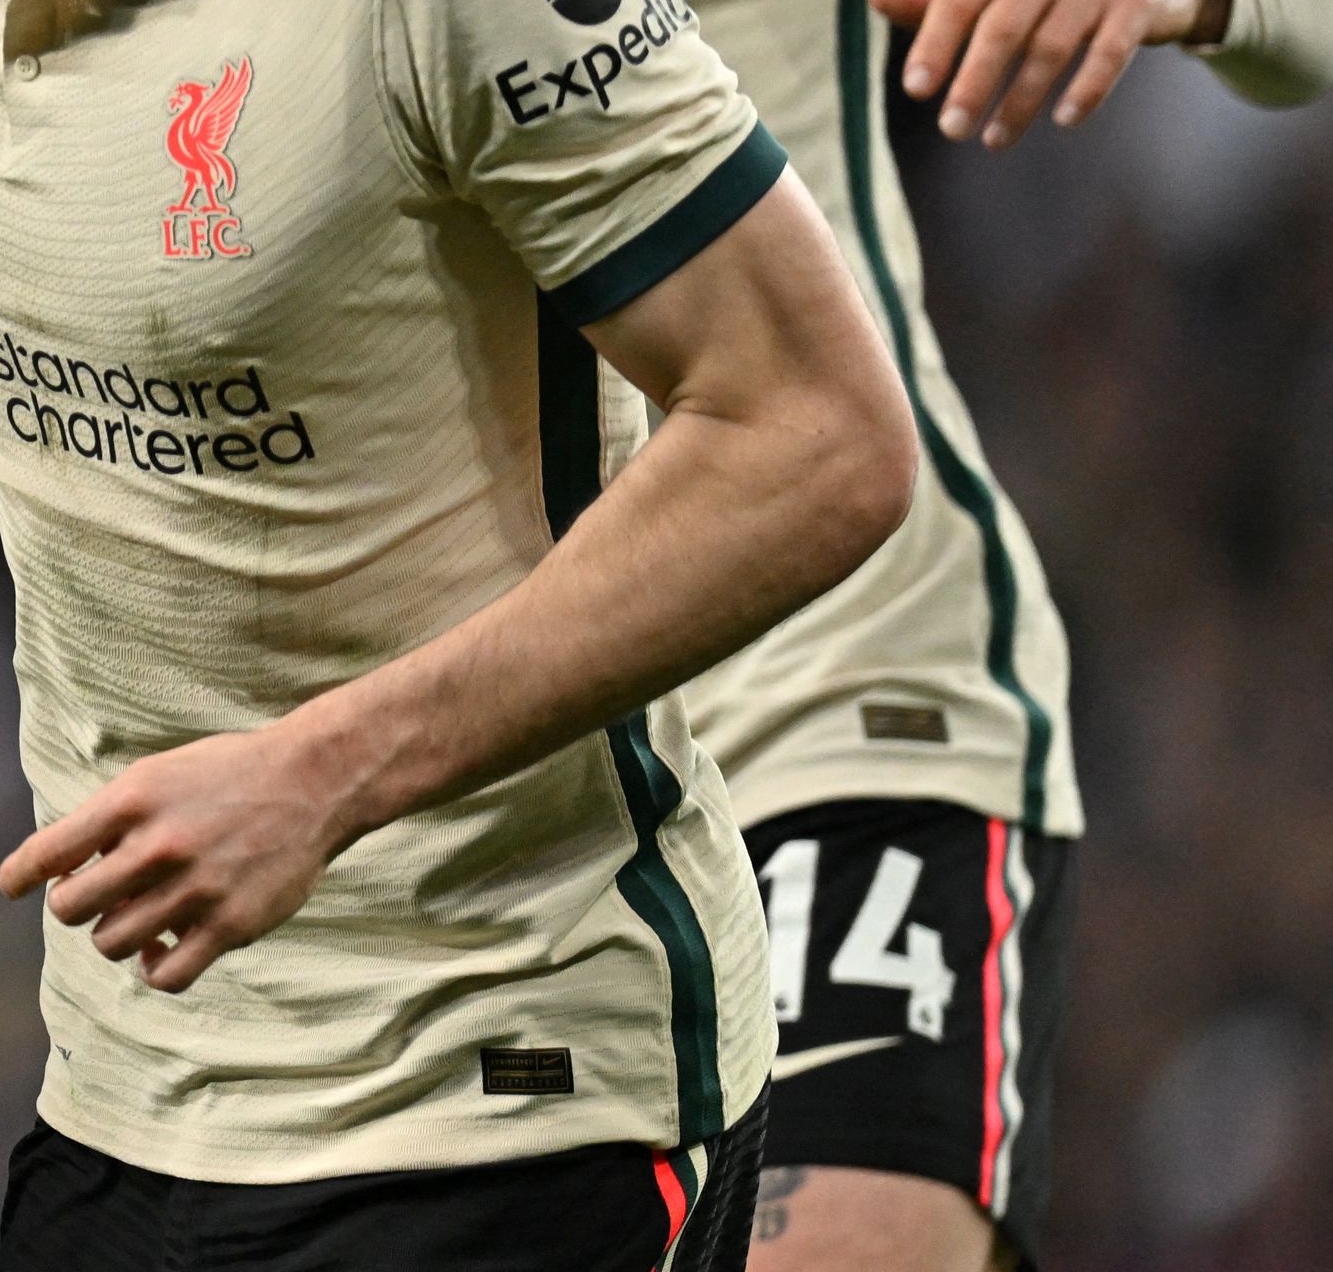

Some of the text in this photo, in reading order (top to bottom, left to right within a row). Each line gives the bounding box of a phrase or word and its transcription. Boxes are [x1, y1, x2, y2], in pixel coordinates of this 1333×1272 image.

[164, 219, 250, 256] L.F.C.
[6, 390, 315, 475] chartered
[758, 839, 957, 1042] 14
